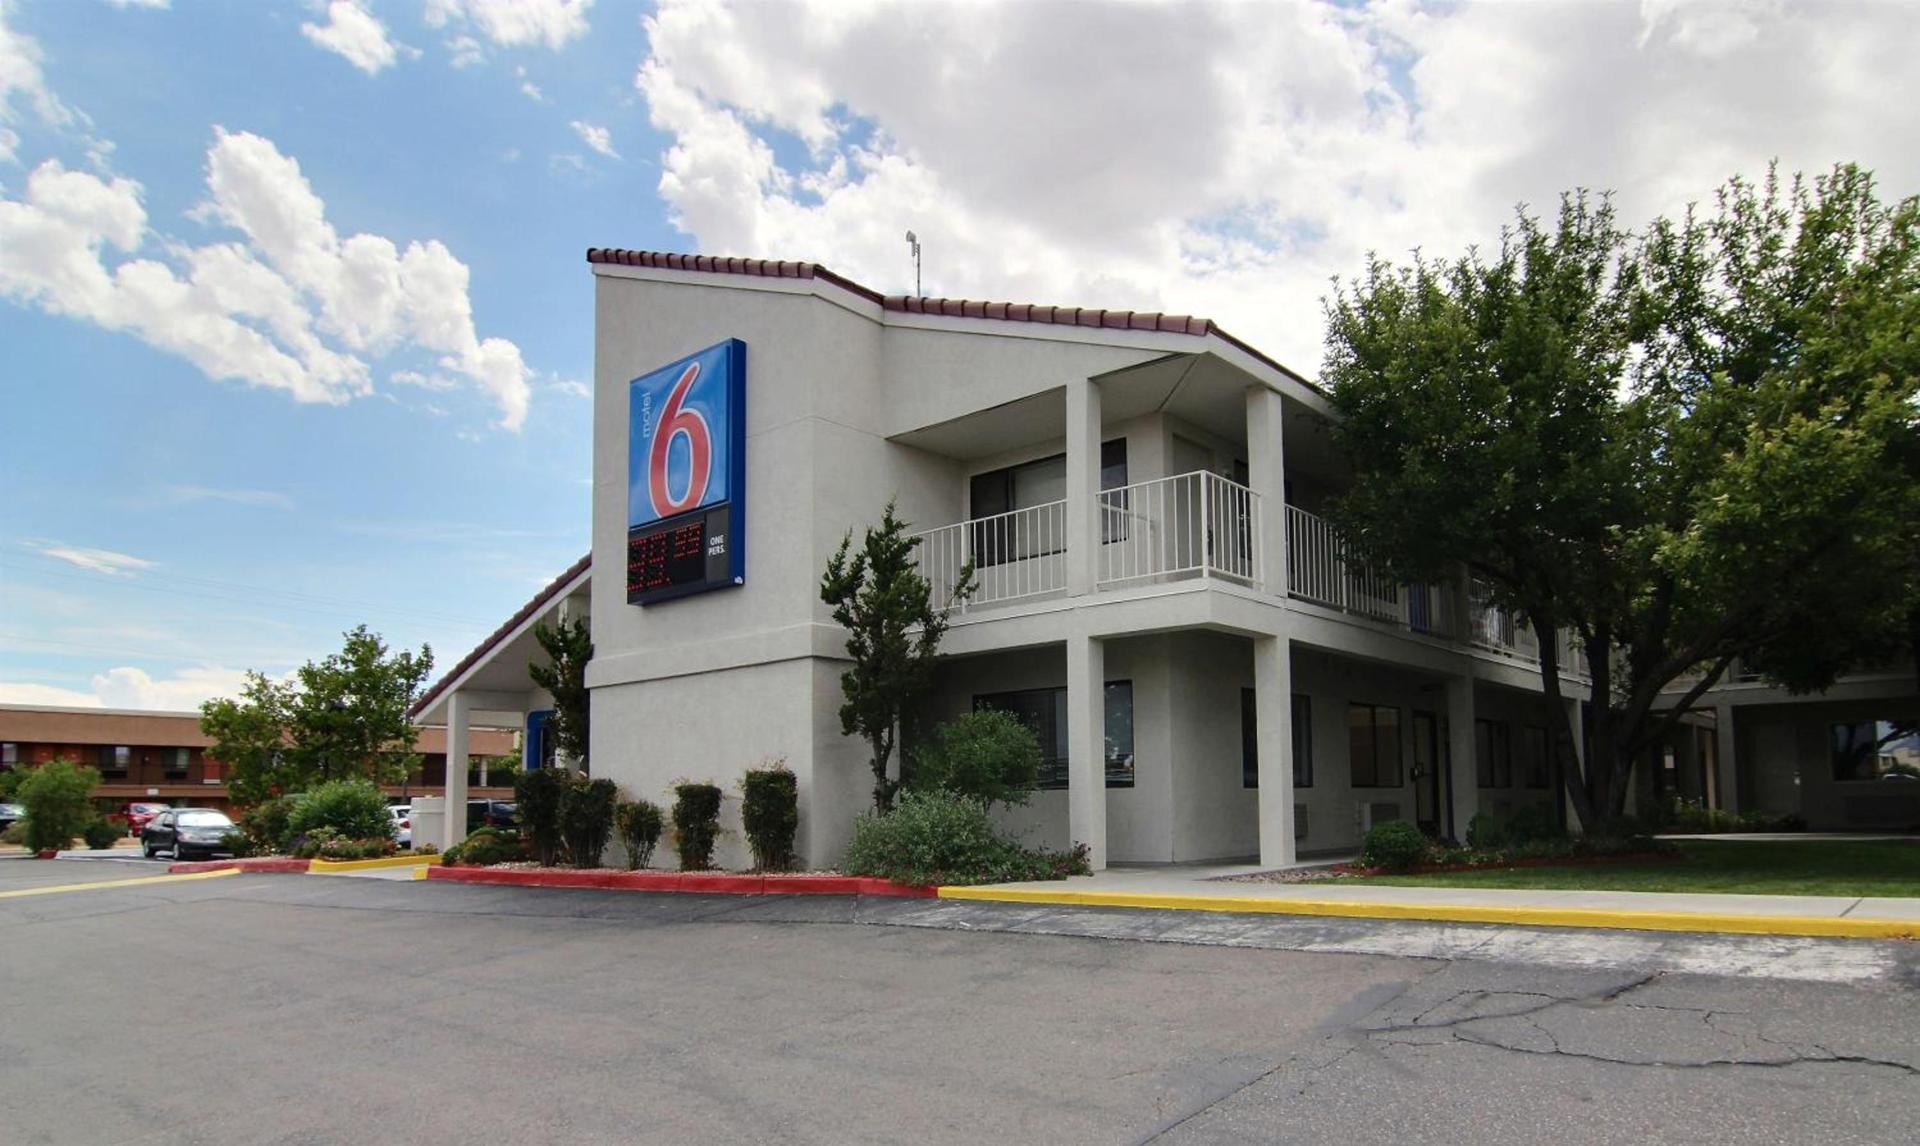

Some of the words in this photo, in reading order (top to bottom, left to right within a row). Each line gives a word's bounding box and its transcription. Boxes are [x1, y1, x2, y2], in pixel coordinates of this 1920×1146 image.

[641, 392, 651, 439] motel
[648, 361, 712, 518] 6
[710, 534, 724, 546] ONE
